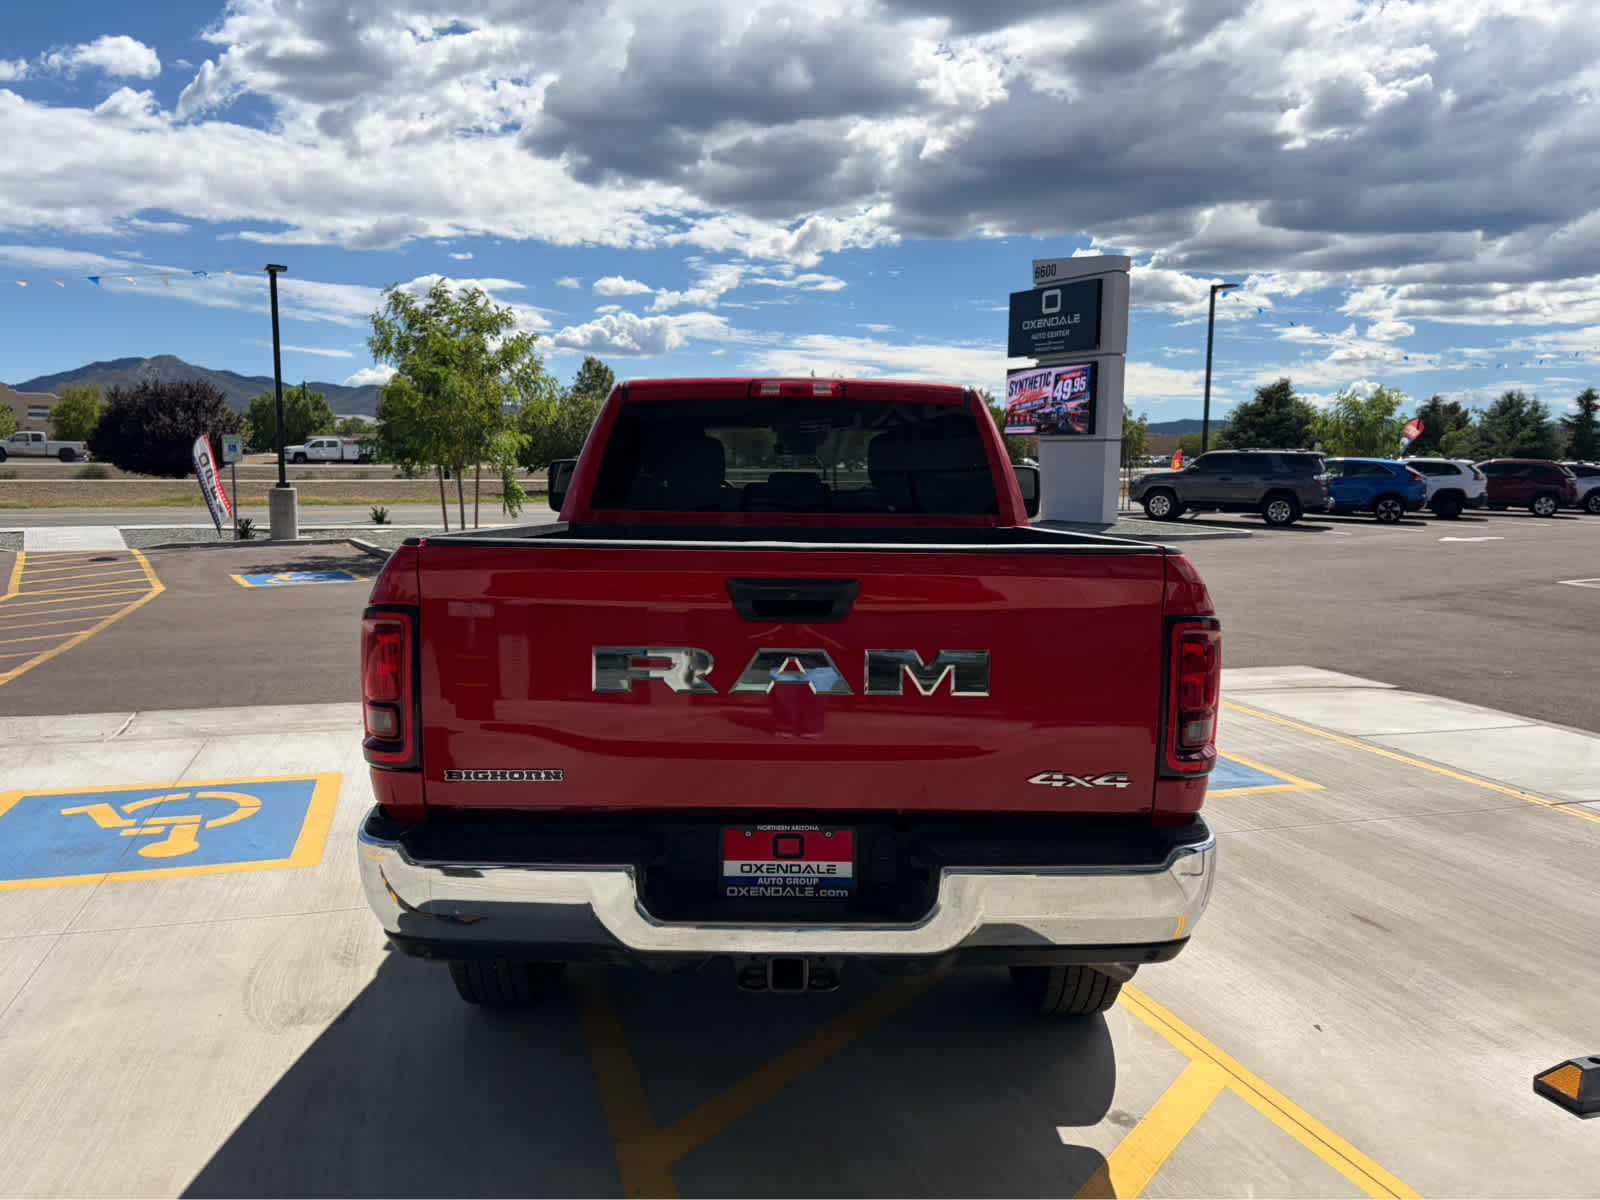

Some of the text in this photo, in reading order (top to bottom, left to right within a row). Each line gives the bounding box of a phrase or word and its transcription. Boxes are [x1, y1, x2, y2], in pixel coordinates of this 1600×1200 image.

[1034, 264, 1057, 280] 6600
[1022, 313, 1081, 330] OXENDALE
[1047, 329, 1070, 338] CENTER
[1008, 371, 1052, 397] SYNTHETIC
[591, 645, 991, 696] RAM
[444, 769, 564, 781] BIGHORN
[740, 863, 837, 875] OXENDALE
[757, 878, 819, 886] AUTO GROUP
[726, 887, 849, 897] OXENDALE.com
